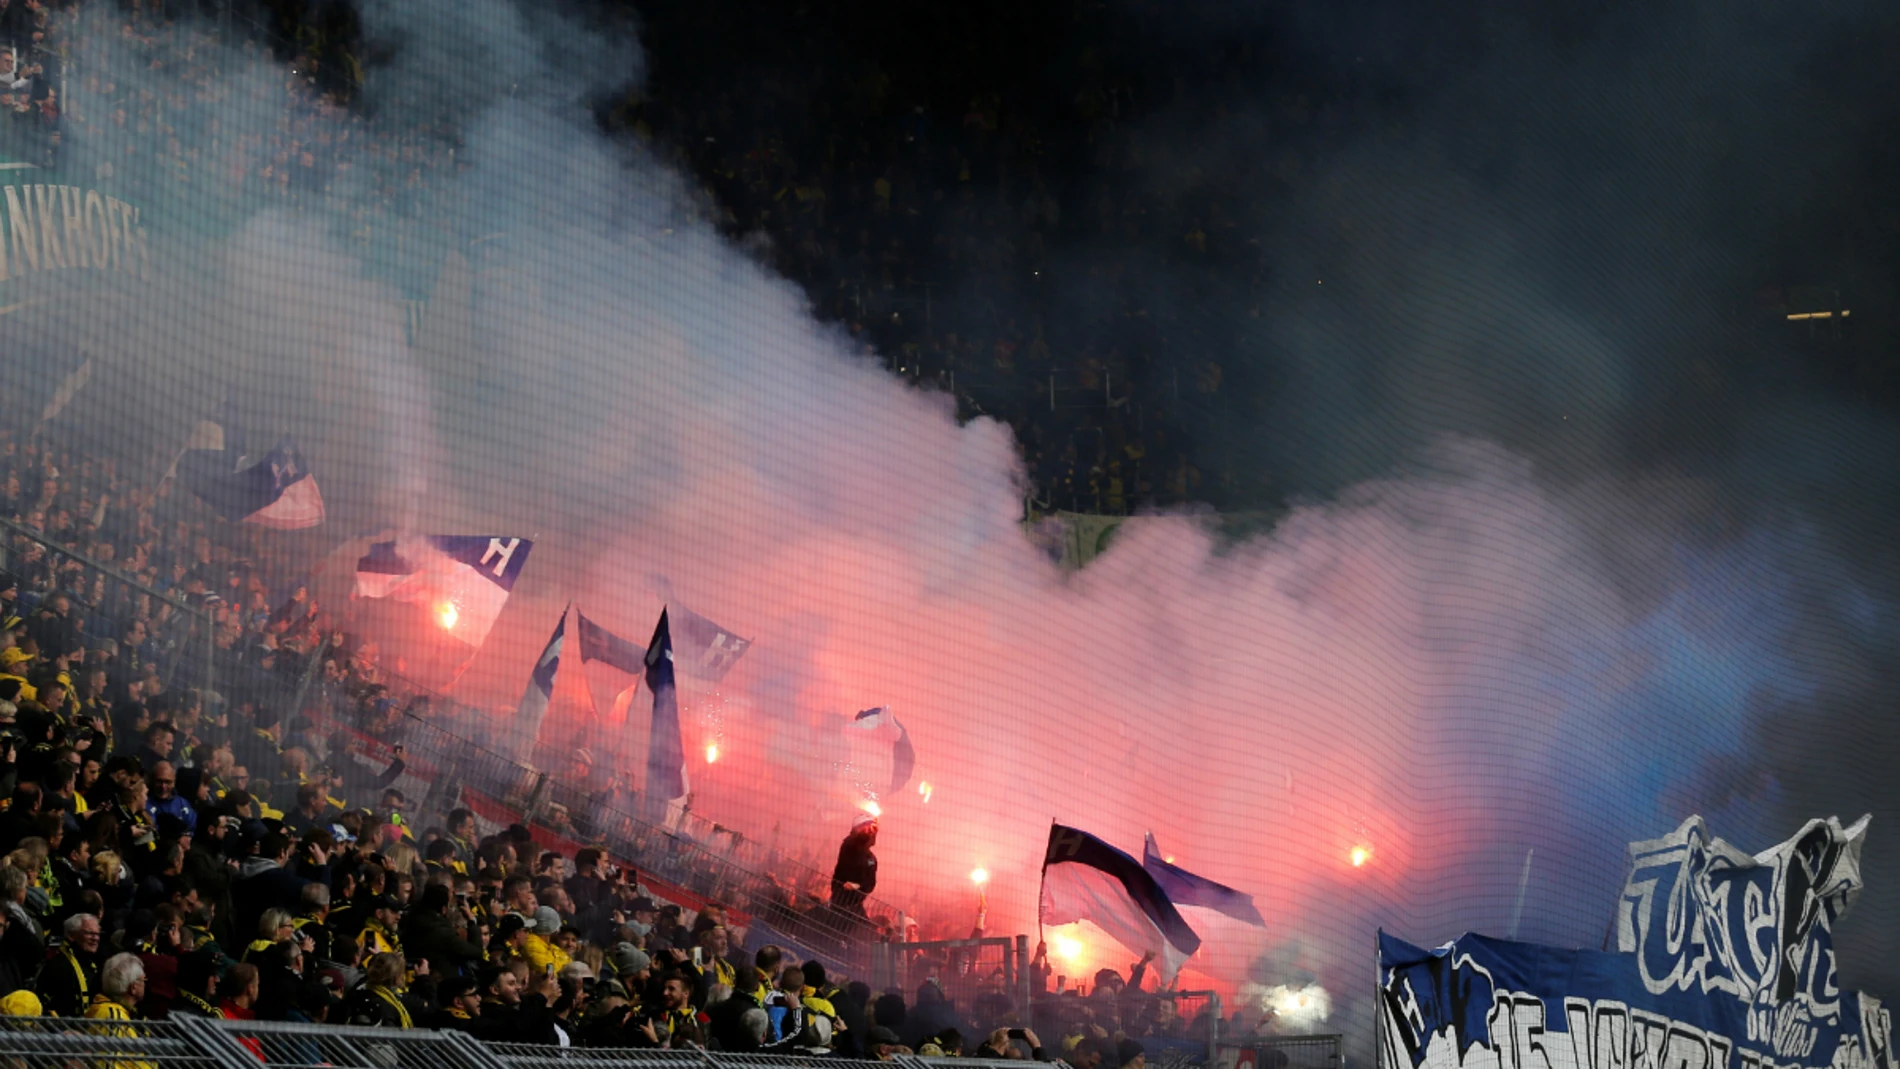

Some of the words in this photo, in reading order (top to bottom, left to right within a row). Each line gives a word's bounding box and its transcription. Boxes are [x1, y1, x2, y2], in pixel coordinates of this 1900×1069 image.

[480, 537, 520, 577] H
[703, 632, 746, 672] H
[1049, 827, 1084, 859] H
